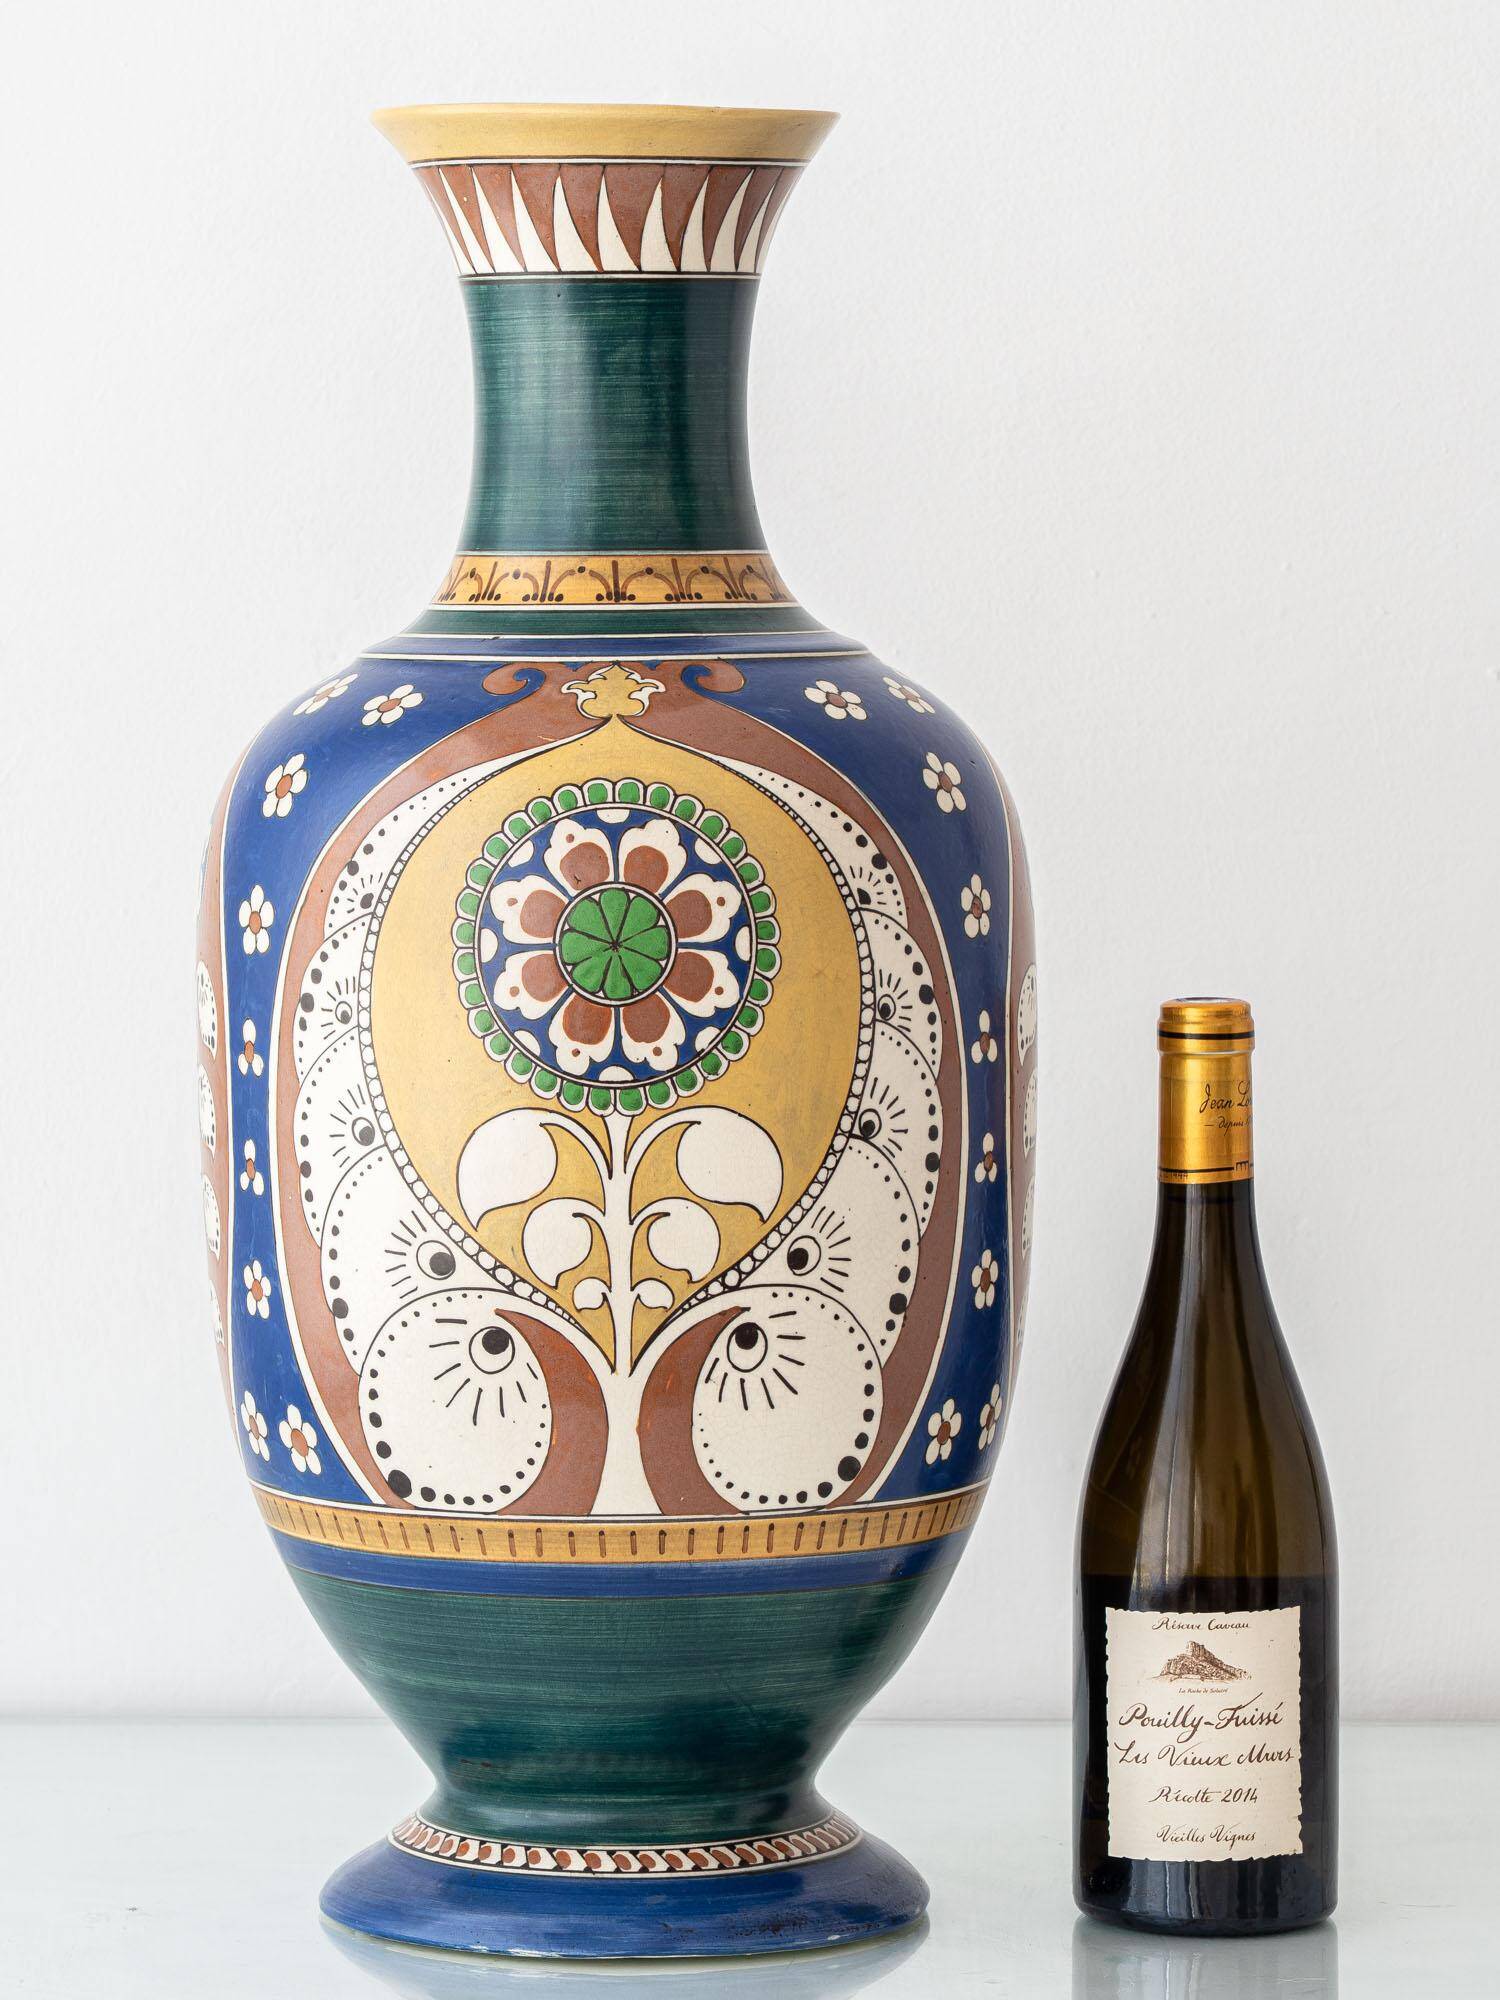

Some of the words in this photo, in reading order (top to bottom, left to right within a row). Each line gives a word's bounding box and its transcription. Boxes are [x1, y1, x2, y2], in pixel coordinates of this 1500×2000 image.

[1199, 1083, 1233, 1113] Jean
[1152, 1616, 1202, 1631] Réserve
[1208, 1618, 1250, 1631] Caveau
[1119, 1692, 1284, 1744] Pouilly-Fuissé
[1114, 1740, 1149, 1765] Les
[1157, 1742, 1231, 1767] Vieux
[1237, 1743, 1295, 1765] Murs
[1149, 1785, 1218, 1804] Récolte
[1220, 1788, 1258, 1804] 2014
[1156, 1824, 1205, 1844] Vieilles
[1209, 1823, 1256, 1851] Vignes
